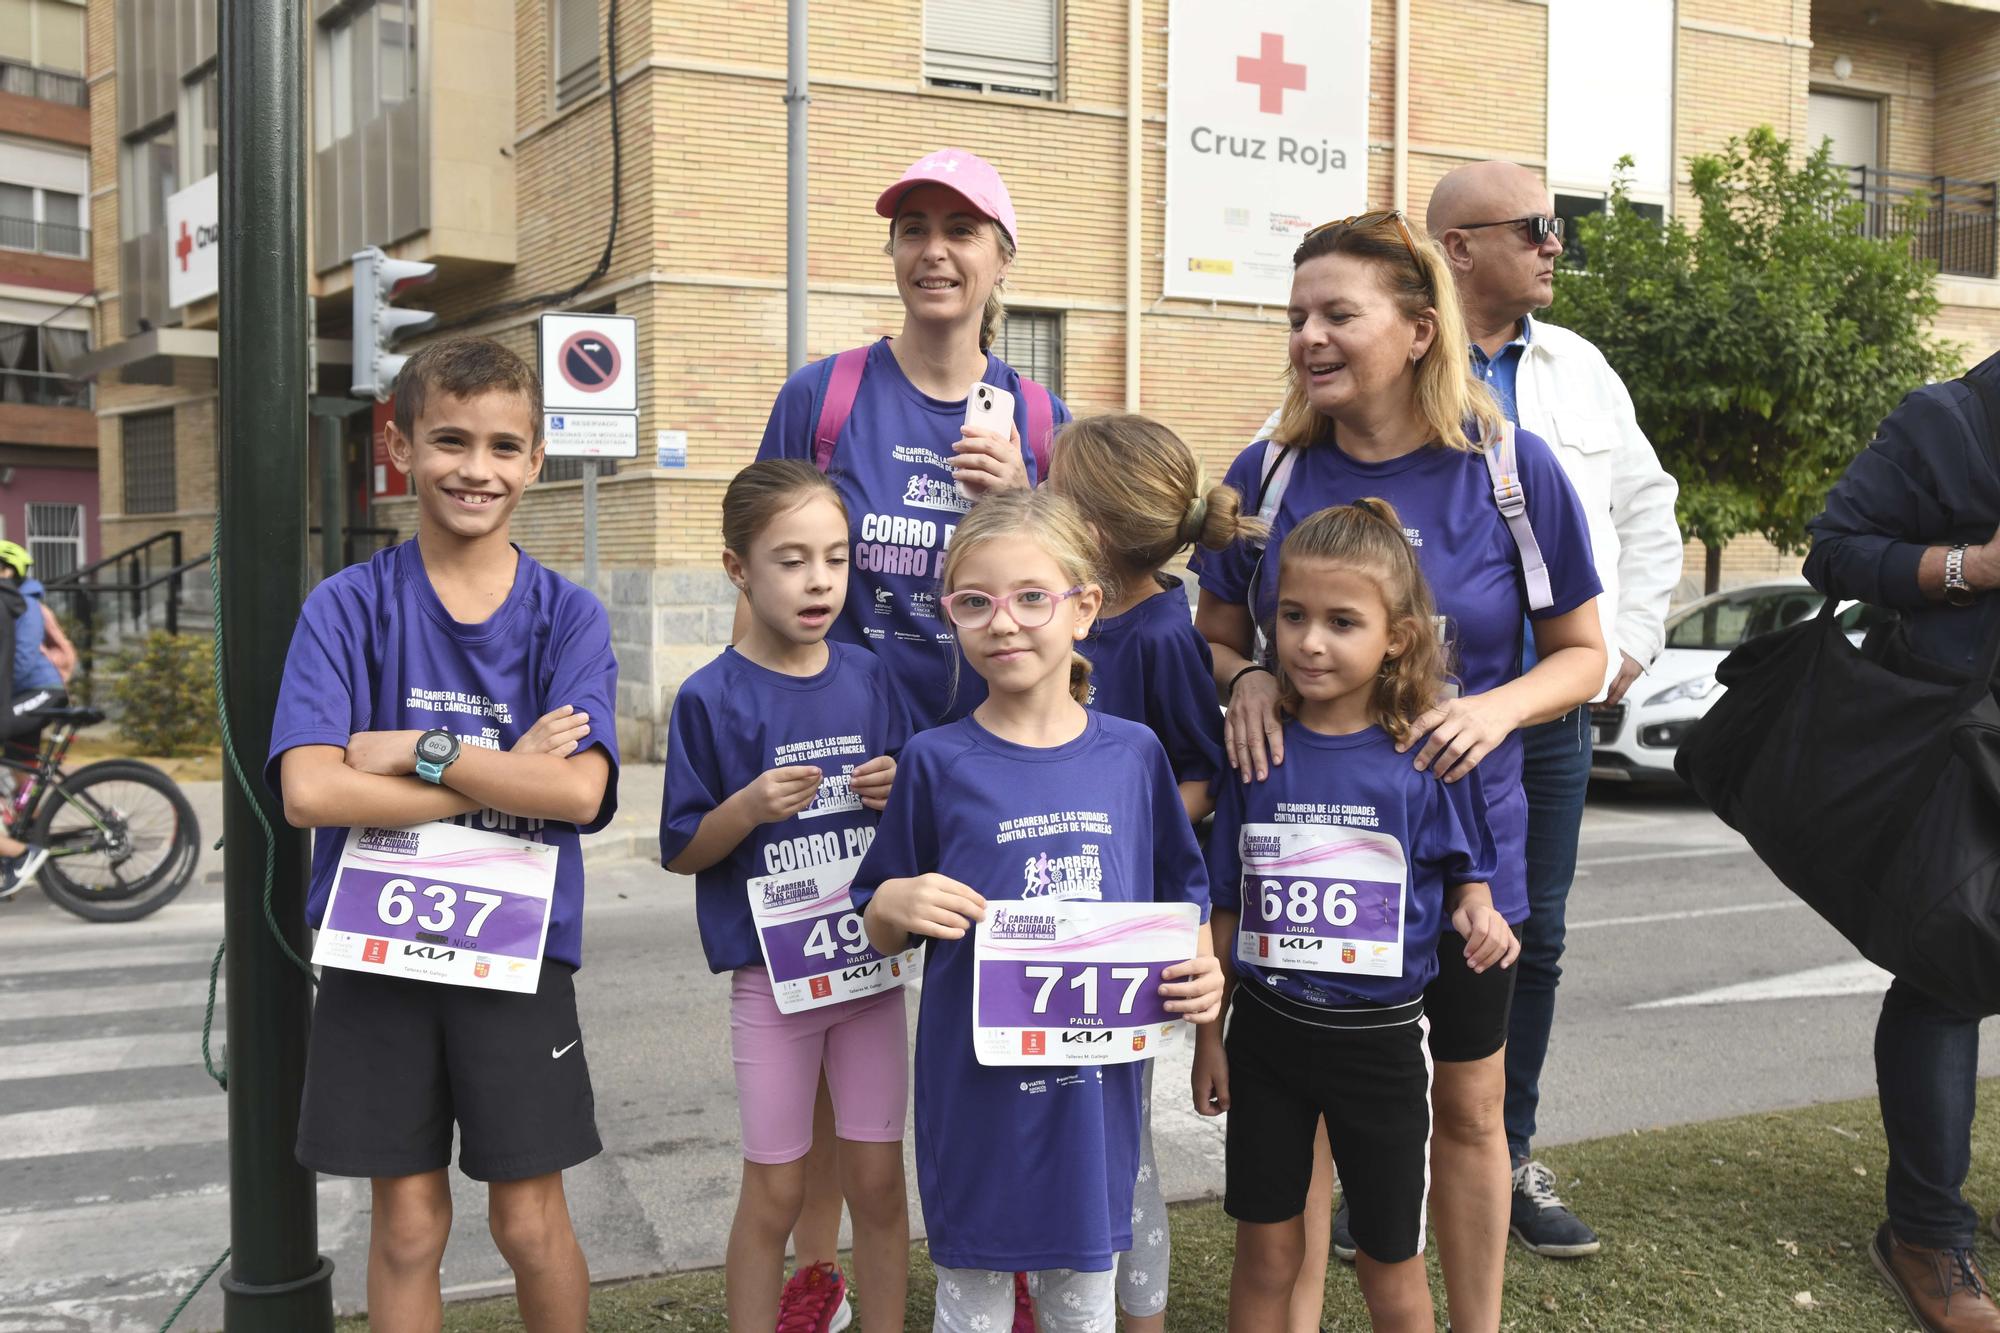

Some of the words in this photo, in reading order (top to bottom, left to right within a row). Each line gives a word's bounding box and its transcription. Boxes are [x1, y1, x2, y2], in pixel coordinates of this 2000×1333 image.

[1191, 126, 1266, 160] Cruz
[1278, 136, 1347, 174] Roja
[195, 223, 219, 248] Cru
[892, 451, 915, 463] CONTRA
[915, 455, 923, 463] EL
[906, 447, 933, 457] CARRERA
[923, 495, 972, 509] CIUDADES
[940, 489, 953, 499] DE
[861, 513, 937, 549] CORRO
[855, 542, 929, 577] CORRO
[411, 687, 423, 699] VIII
[423, 690, 456, 701] CARRERA
[457, 692, 467, 702] DE
[467, 694, 482, 705] LAS
[406, 697, 433, 711] CONTRA
[434, 702, 443, 711] EL
[444, 700, 472, 714] CÁNCER
[472, 706, 482, 715] DE
[481, 727, 500, 739] 2022
[455, 733, 501, 751] ARRERA
[775, 745, 786, 756] VIII
[786, 740, 816, 753] CARRERA
[814, 738, 825, 748] DE
[824, 737, 837, 747] LAS
[836, 735, 862, 745] CIUDADES
[774, 753, 798, 766] CONTRA
[798, 751, 807, 761] EL
[831, 746, 840, 756] DE
[832, 785, 845, 797] DE
[817, 793, 861, 809] CIUDADES
[1277, 803, 1287, 812] VIII
[1287, 803, 1316, 813] CARRERA
[1317, 803, 1327, 813] DE
[1327, 804, 1341, 814] LAS
[1341, 804, 1376, 816] CIUDADES
[999, 820, 1013, 832] VIII
[1013, 815, 1049, 828] CARRERA
[1049, 812, 1061, 822] DE
[1061, 811, 1077, 822] LAS
[1077, 811, 1109, 823] CIUDADES
[1274, 813, 1296, 823] CONTRA
[1297, 813, 1305, 824] EL
[1305, 813, 1332, 824] CÁNCER
[1332, 815, 1342, 824] DE
[1343, 814, 1380, 827] PÁNCREAS
[378, 829, 409, 840] CARRERA
[410, 832, 420, 841] DE
[996, 829, 1027, 844] CONTRA
[1028, 828, 1038, 838] EL
[1038, 824, 1069, 837] CÁNCER
[1070, 821, 1081, 832] DE
[1273, 836, 1281, 844] DE
[385, 838, 420, 850] CIUDADES
[763, 831, 842, 875] CORRO
[844, 826, 877, 858] POR
[1081, 844, 1099, 855] 2022
[1252, 843, 1281, 852] CIUDADES
[1048, 855, 1101, 872] CARRERA
[1066, 868, 1083, 880] DE
[1084, 868, 1102, 881] LAS
[772, 892, 785, 903] LAS
[785, 885, 818, 900] CIUDADES
[776, 880, 807, 894] CARRERA
[807, 878, 816, 887] DE
[1048, 879, 1101, 895] CIUDADES
[377, 878, 503, 938] 637
[1260, 879, 1358, 927] 686
[1009, 915, 1044, 924] CARRERA
[1045, 915, 1055, 925] DE
[803, 913, 870, 960] 49
[1002, 923, 1016, 933] LAS
[1017, 923, 1057, 935] CIUDADES
[1286, 925, 1315, 934] LAURA
[1279, 937, 1323, 950] KIA
[404, 944, 455, 961] KIA
[847, 953, 873, 965] MARTI
[842, 962, 882, 981] KIA
[1024, 965, 1150, 1015] 717
[1070, 1017, 1104, 1026] PAULA
[1062, 1031, 1112, 1043] KIA
